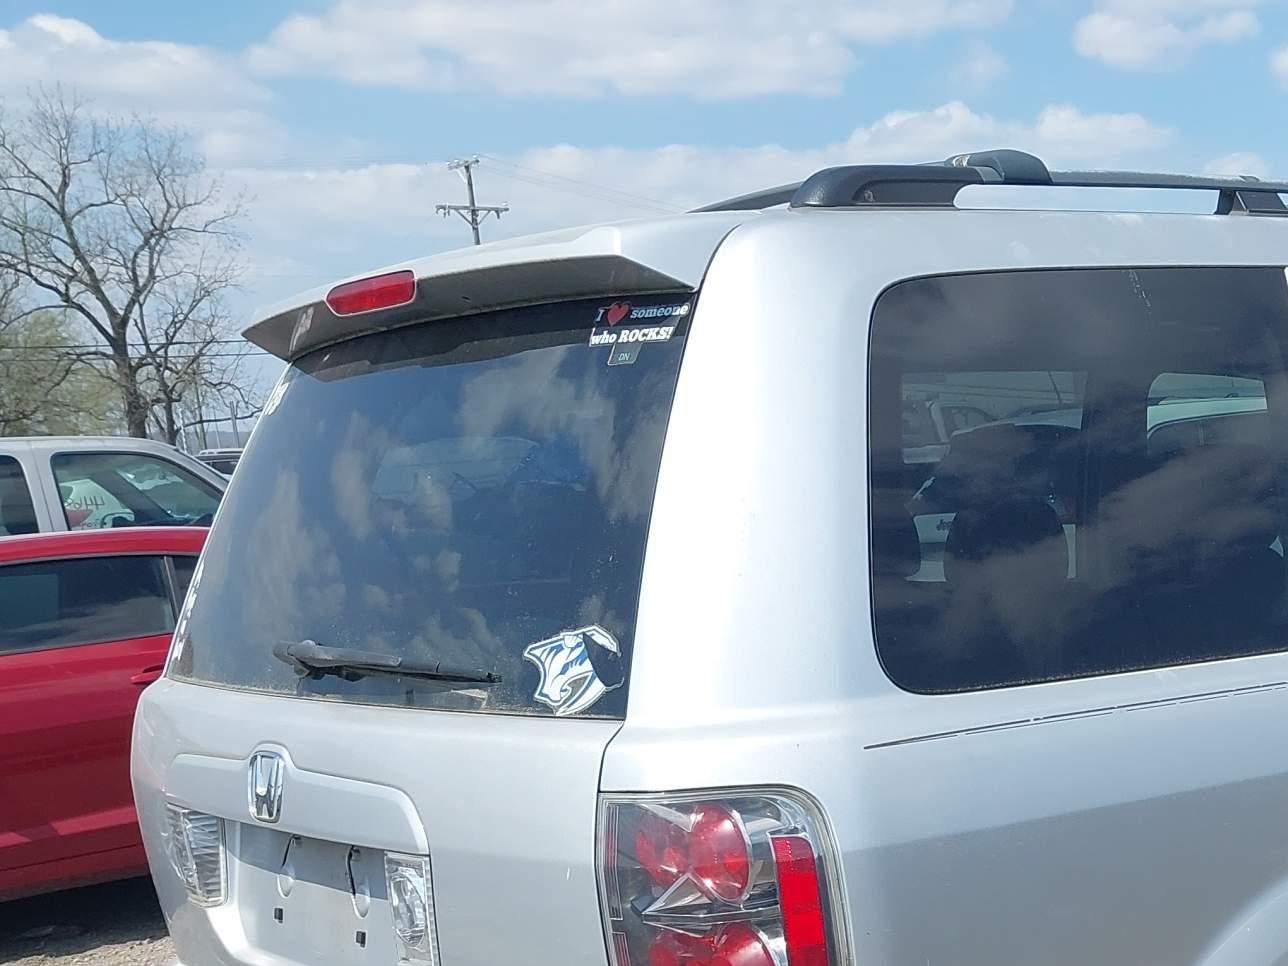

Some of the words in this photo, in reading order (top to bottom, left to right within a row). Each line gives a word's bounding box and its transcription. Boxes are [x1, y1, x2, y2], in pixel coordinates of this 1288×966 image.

[630, 305, 689, 319] someone
[591, 331, 617, 345] who
[618, 327, 675, 343] ROCKS!
